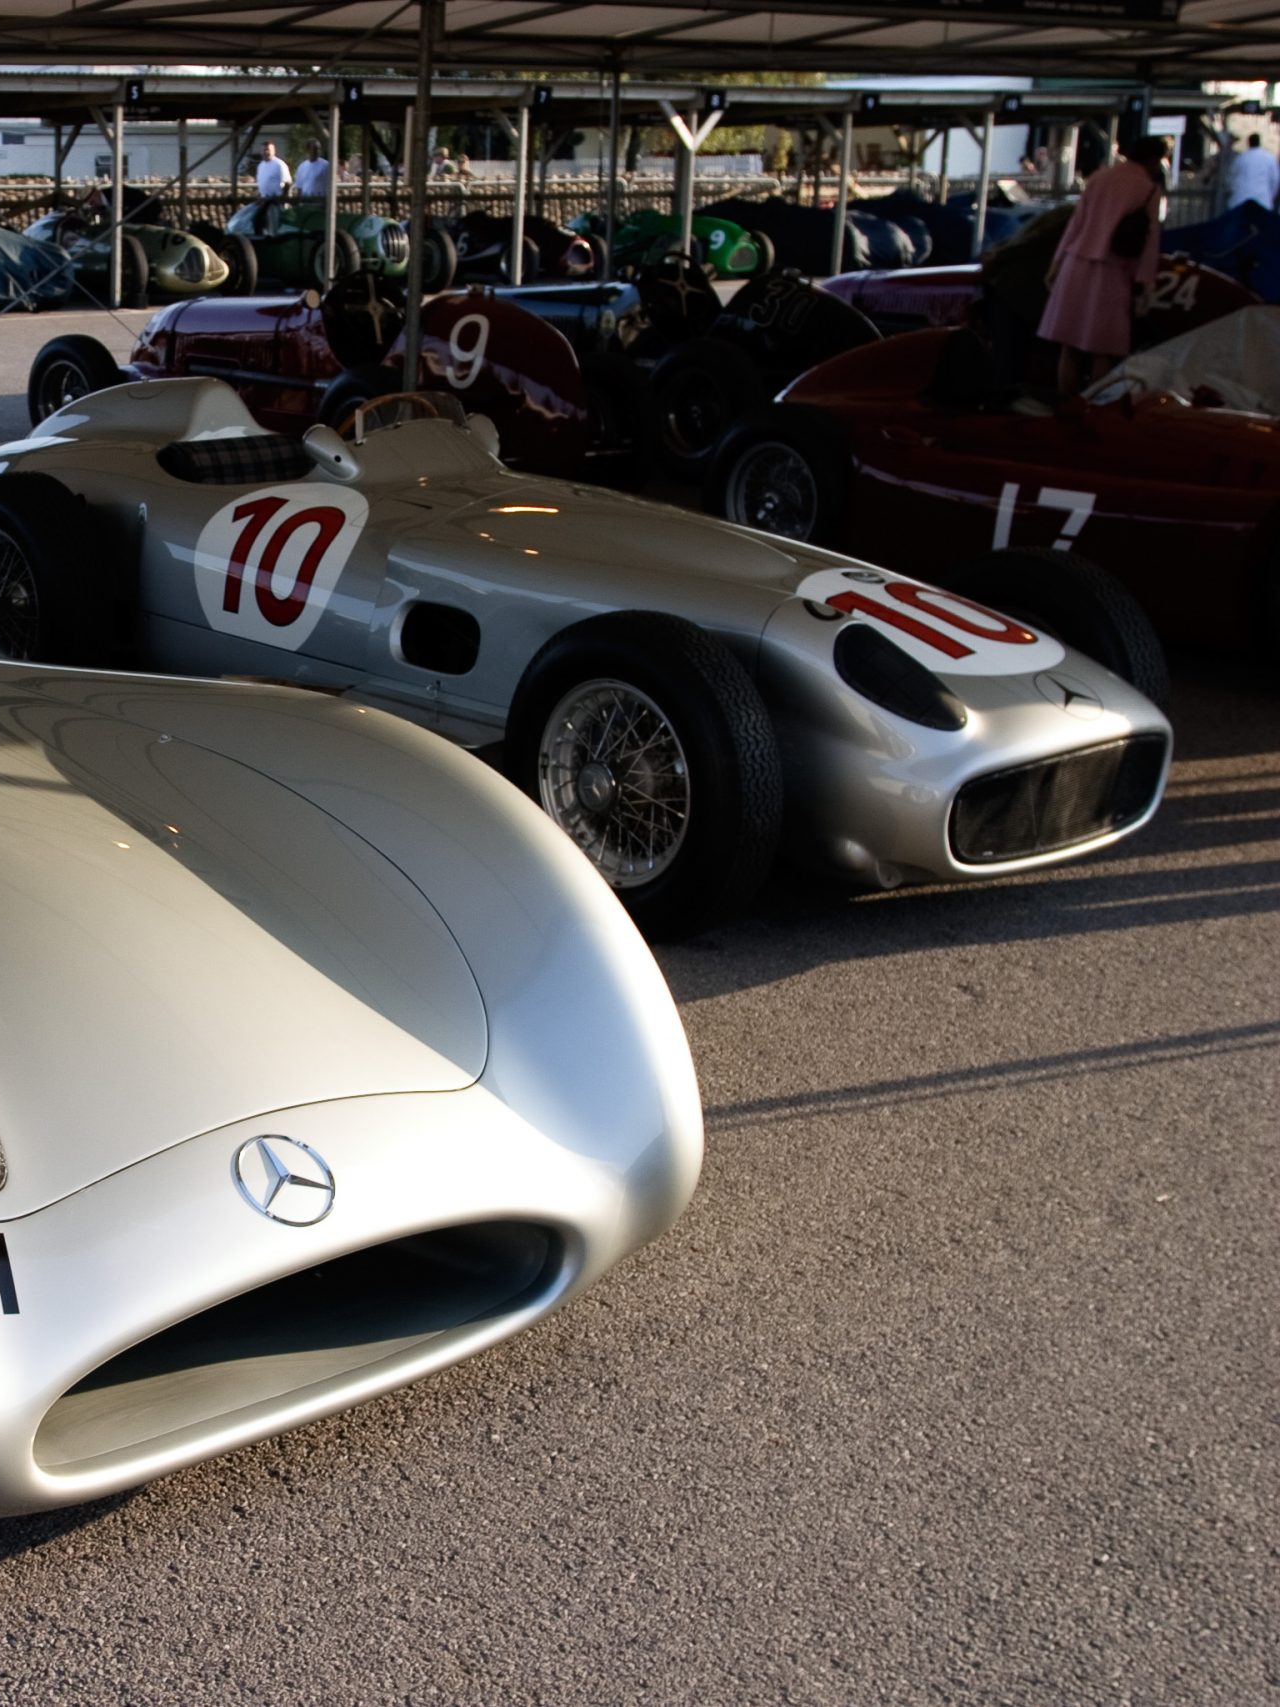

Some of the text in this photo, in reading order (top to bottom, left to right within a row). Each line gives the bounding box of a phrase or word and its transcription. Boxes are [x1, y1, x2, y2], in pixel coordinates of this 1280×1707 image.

[131, 85, 139, 99] 5
[456, 232, 470, 256] 6
[710, 230, 725, 249] 9
[1148, 270, 1200, 312] 24
[446, 314, 489, 389] 9
[992, 482, 1096, 551] 17
[223, 496, 346, 627] 10
[825, 582, 1039, 659] 10
